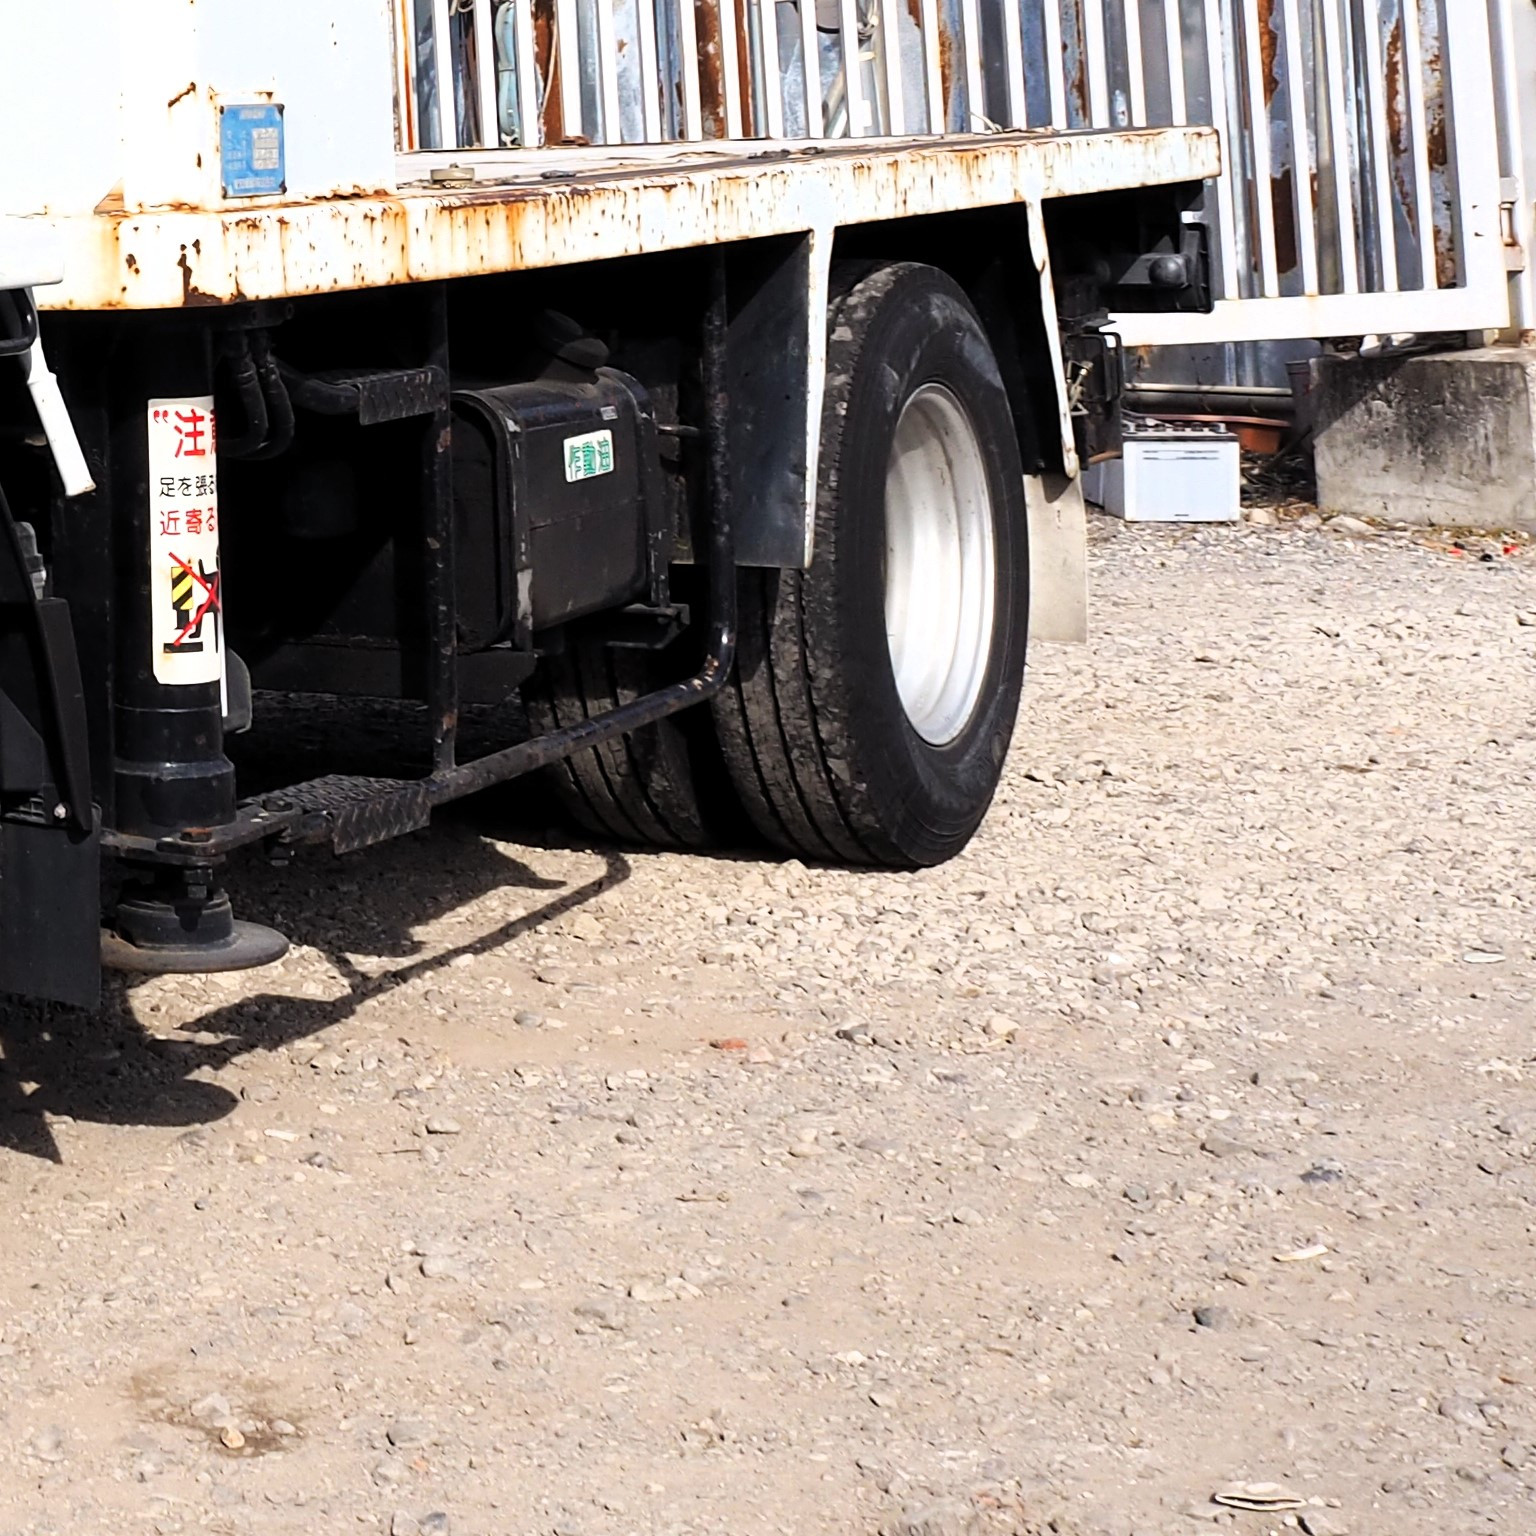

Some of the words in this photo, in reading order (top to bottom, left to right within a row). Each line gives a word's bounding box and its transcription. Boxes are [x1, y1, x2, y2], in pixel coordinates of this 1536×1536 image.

[569, 436, 611, 479] 作動油
[160, 507, 216, 536] 近寄る
